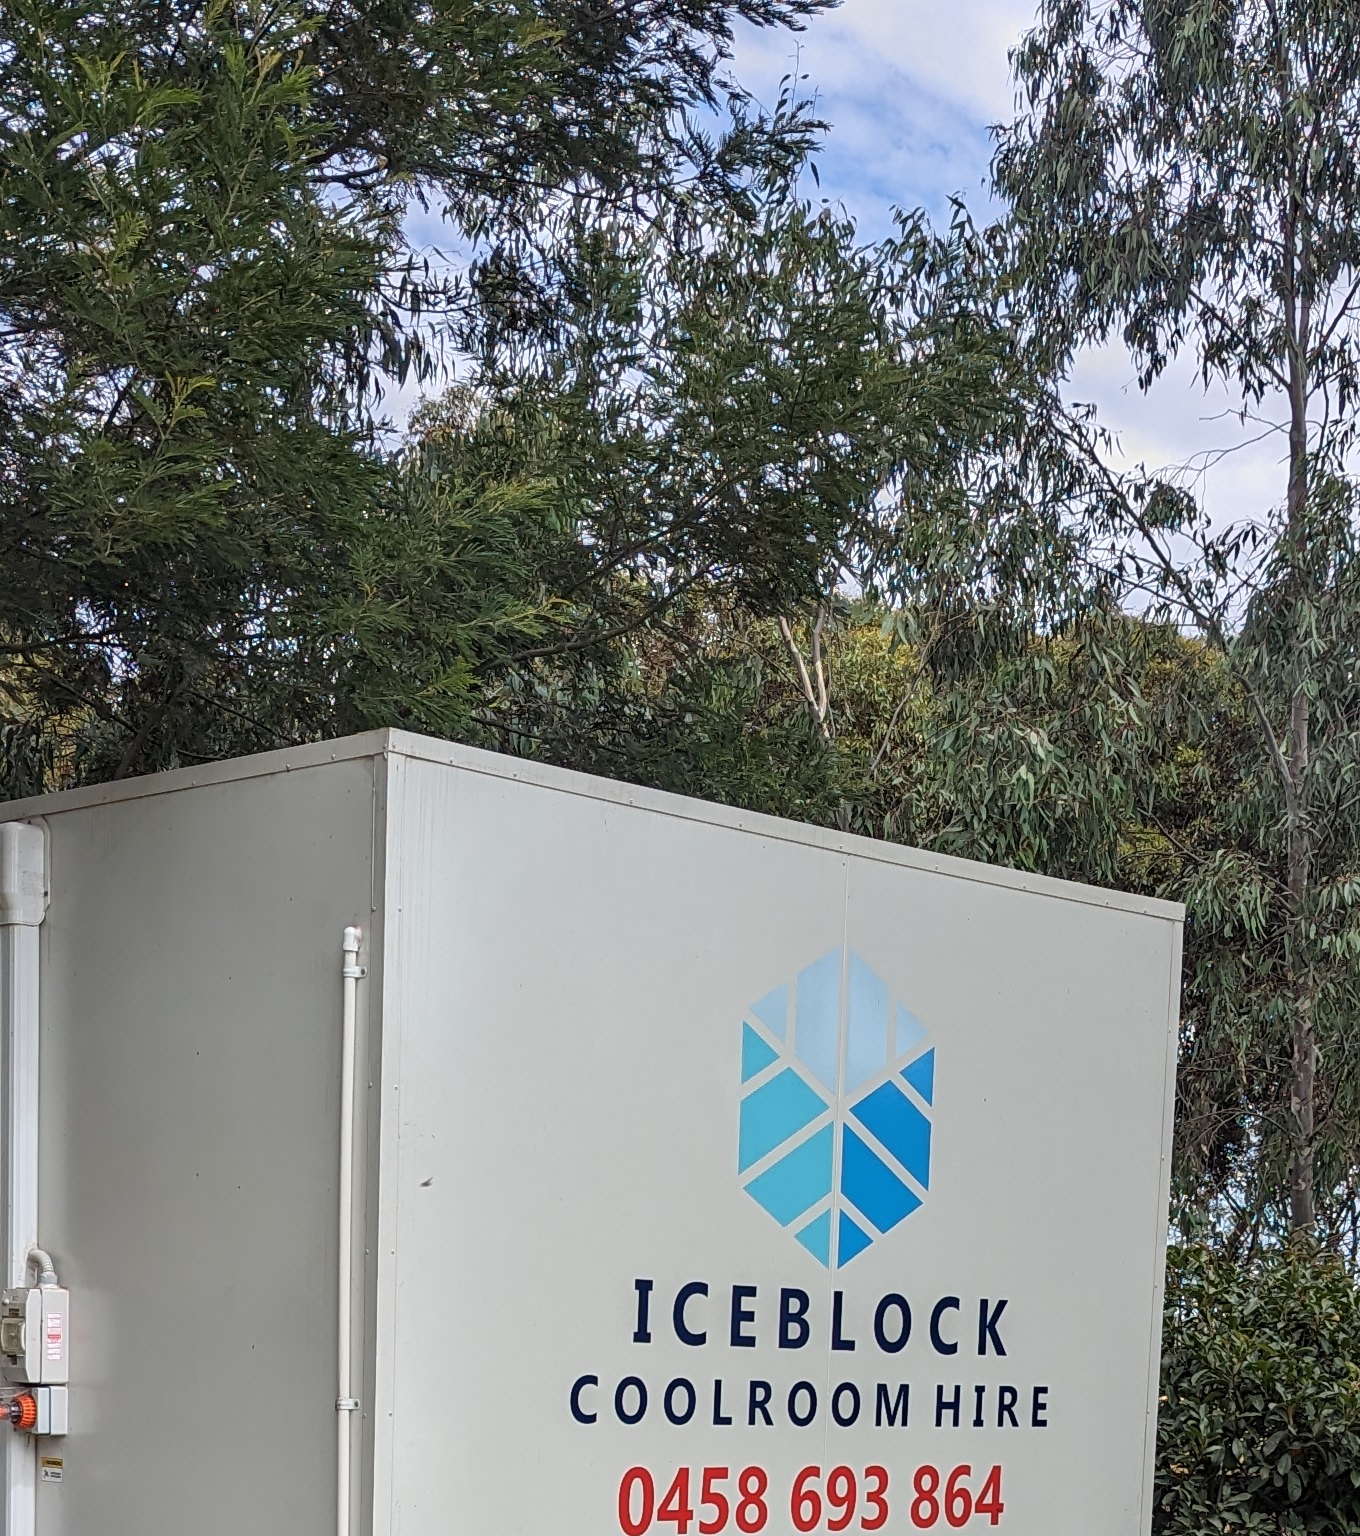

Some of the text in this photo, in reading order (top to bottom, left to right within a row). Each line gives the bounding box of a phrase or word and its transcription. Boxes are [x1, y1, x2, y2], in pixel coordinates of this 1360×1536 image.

[632, 1278, 1009, 1357] ICEBLOCK
[569, 1374, 1049, 1428] COOLROOM HIRE
[789, 1464, 890, 1533] 693
[909, 1463, 1005, 1530] 864
